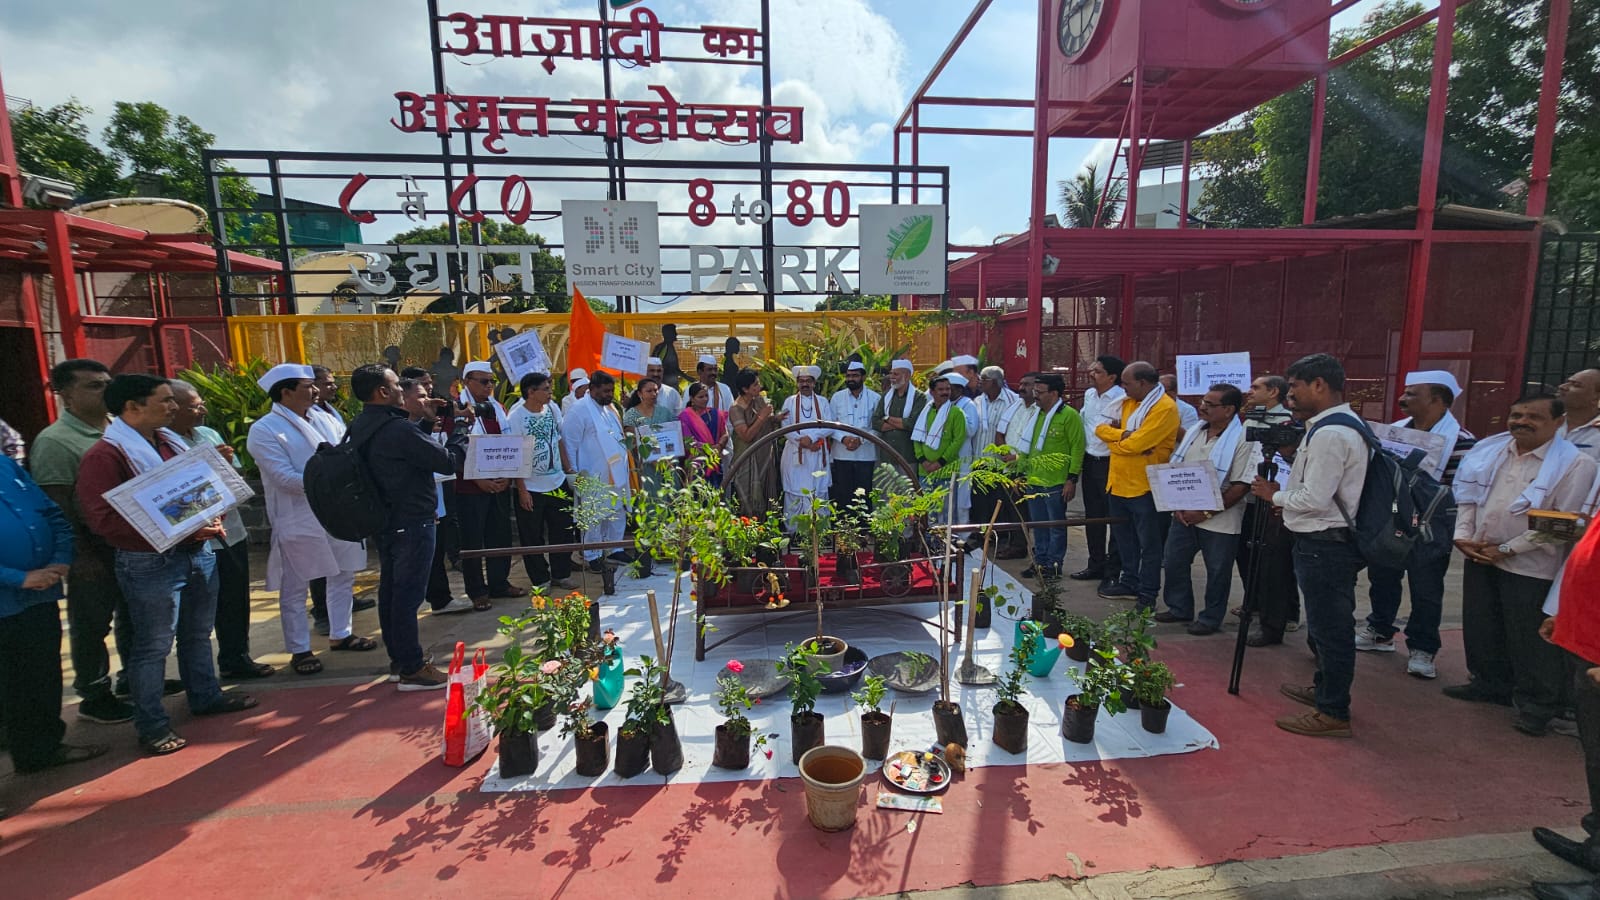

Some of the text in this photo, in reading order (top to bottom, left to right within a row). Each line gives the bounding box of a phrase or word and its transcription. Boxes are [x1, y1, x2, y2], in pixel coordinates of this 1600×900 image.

[445, 7, 760, 74] आज़ादी का
[391, 85, 804, 154] अमृत महोत्सव
[687, 178, 851, 228] 8 to 80
[344, 243, 541, 295] उद्यान
[572, 263, 655, 279] Smart City
[689, 245, 854, 295] PARK
